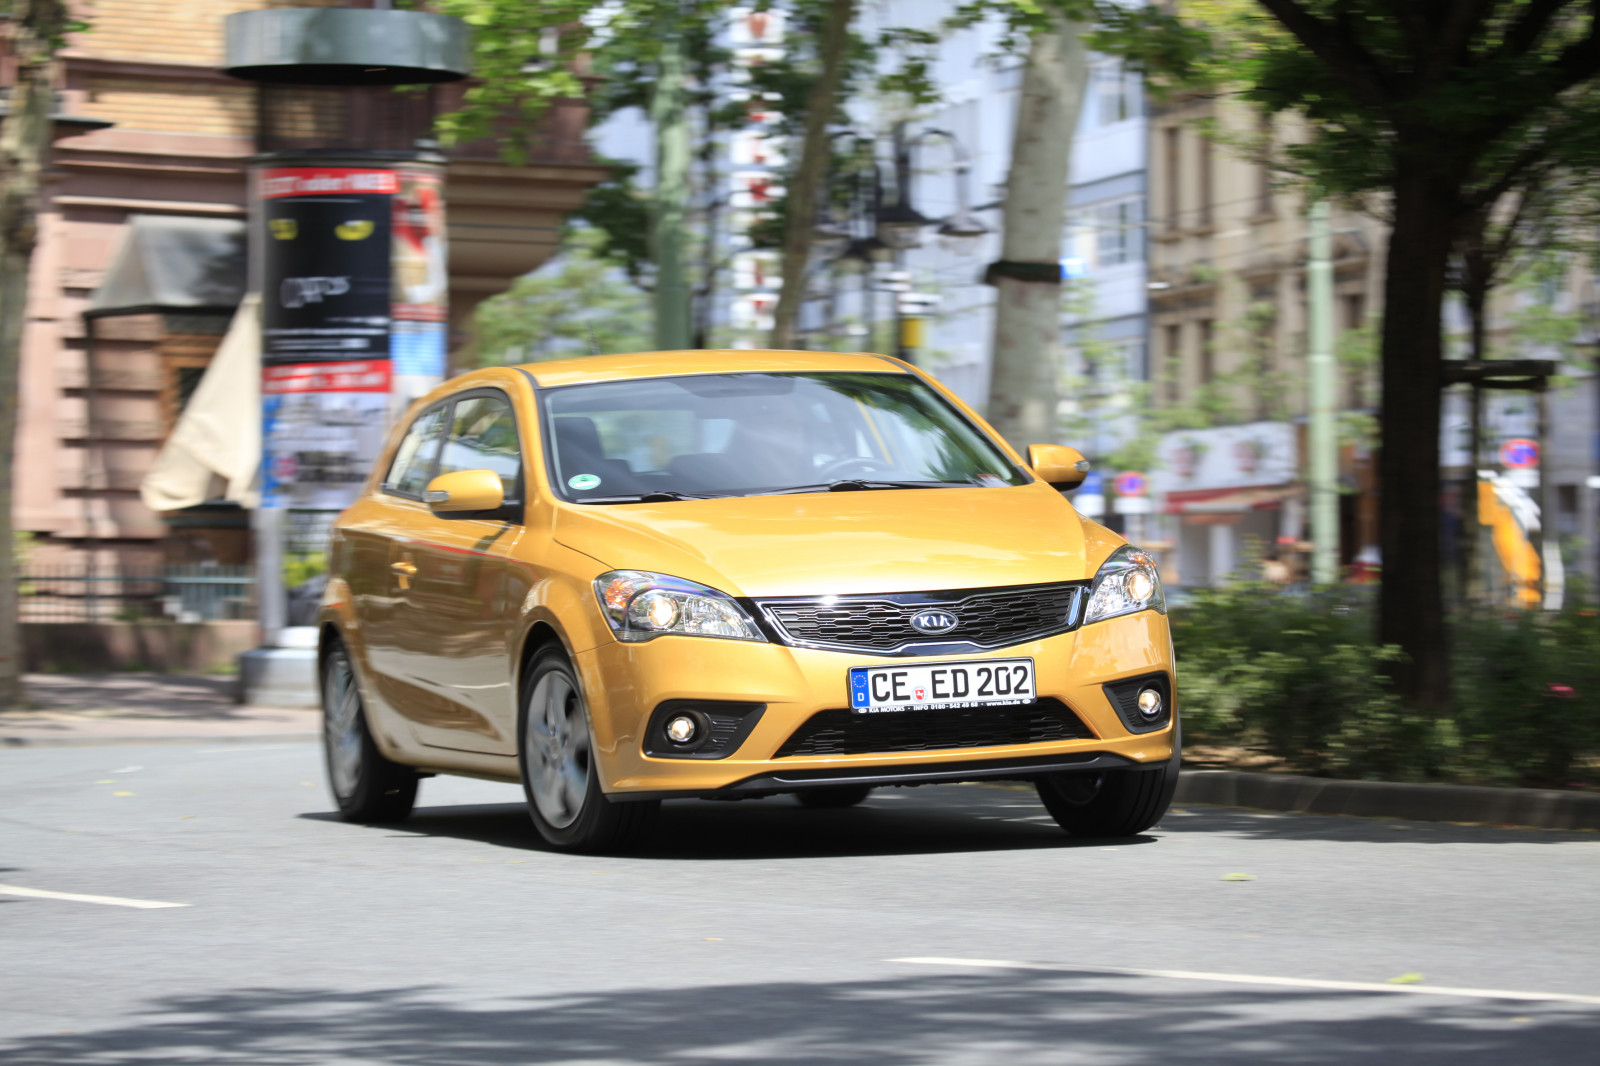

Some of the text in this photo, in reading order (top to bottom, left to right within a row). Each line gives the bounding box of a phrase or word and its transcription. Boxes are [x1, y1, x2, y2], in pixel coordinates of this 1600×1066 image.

[918, 614, 950, 627] KIA
[871, 665, 1030, 702] CE ED 202
[857, 692, 865, 702] D
